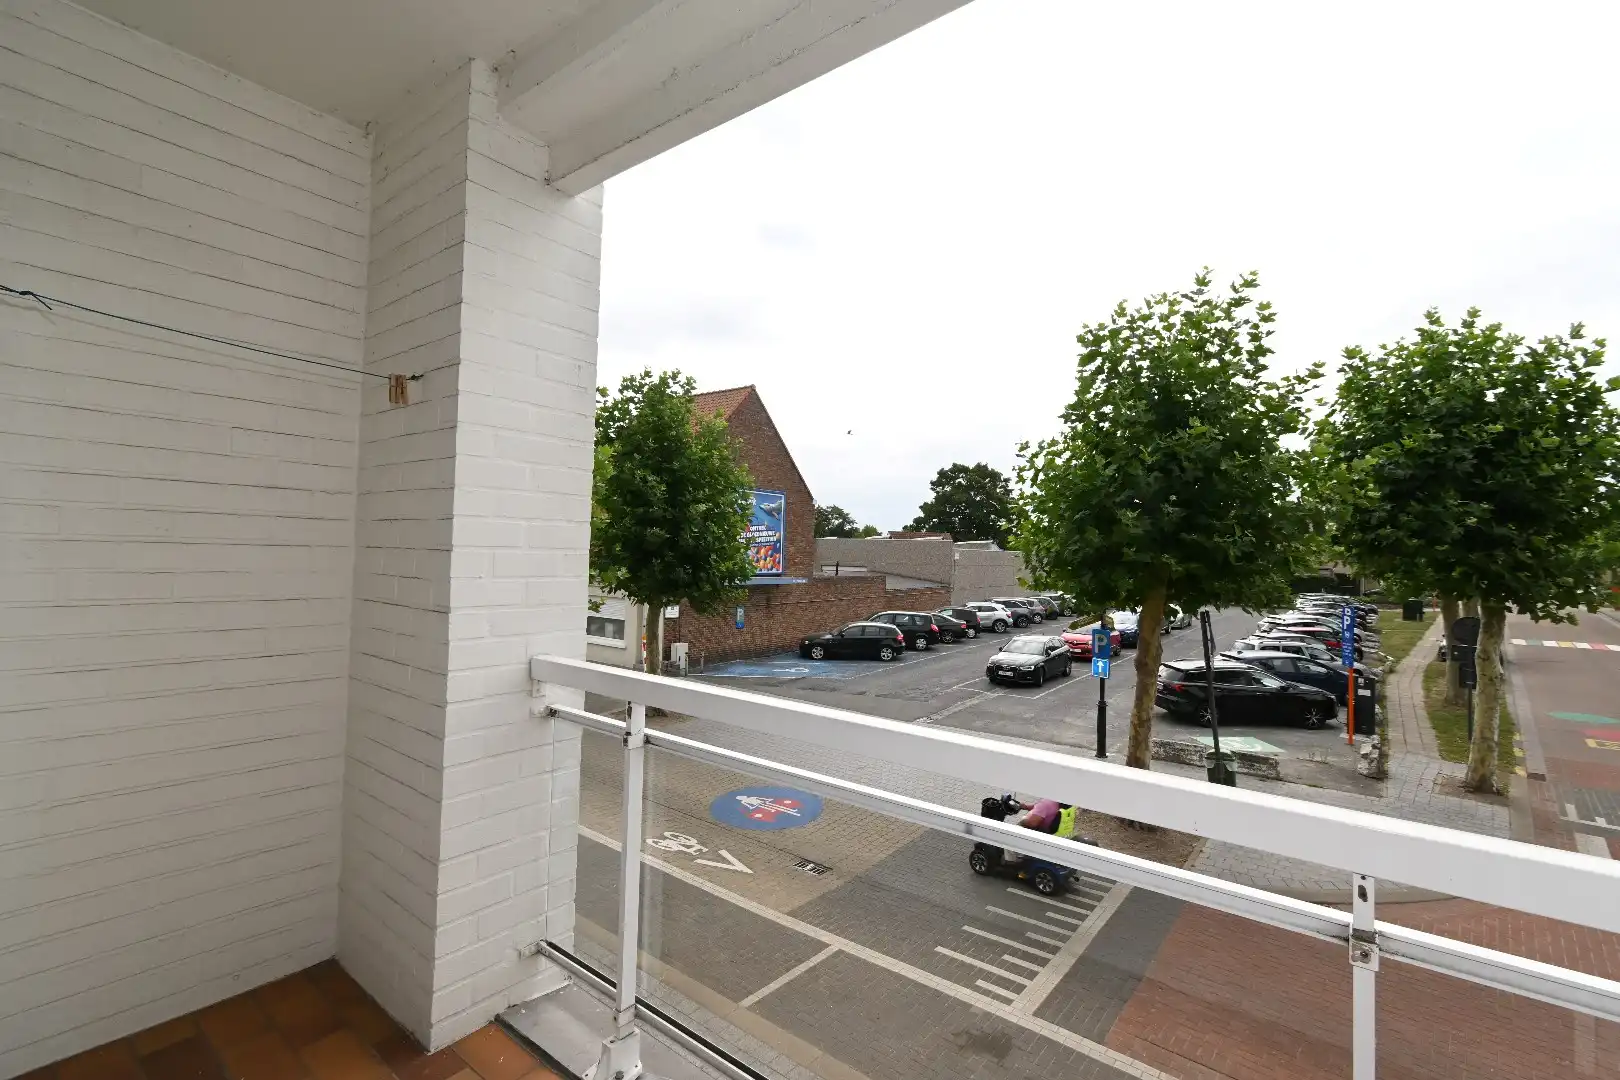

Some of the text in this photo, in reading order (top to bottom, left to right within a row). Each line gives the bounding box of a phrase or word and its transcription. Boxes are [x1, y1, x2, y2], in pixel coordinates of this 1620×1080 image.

[737, 608, 744, 620] P
[1344, 616, 1350, 629] P
[1095, 634, 1107, 653] P
